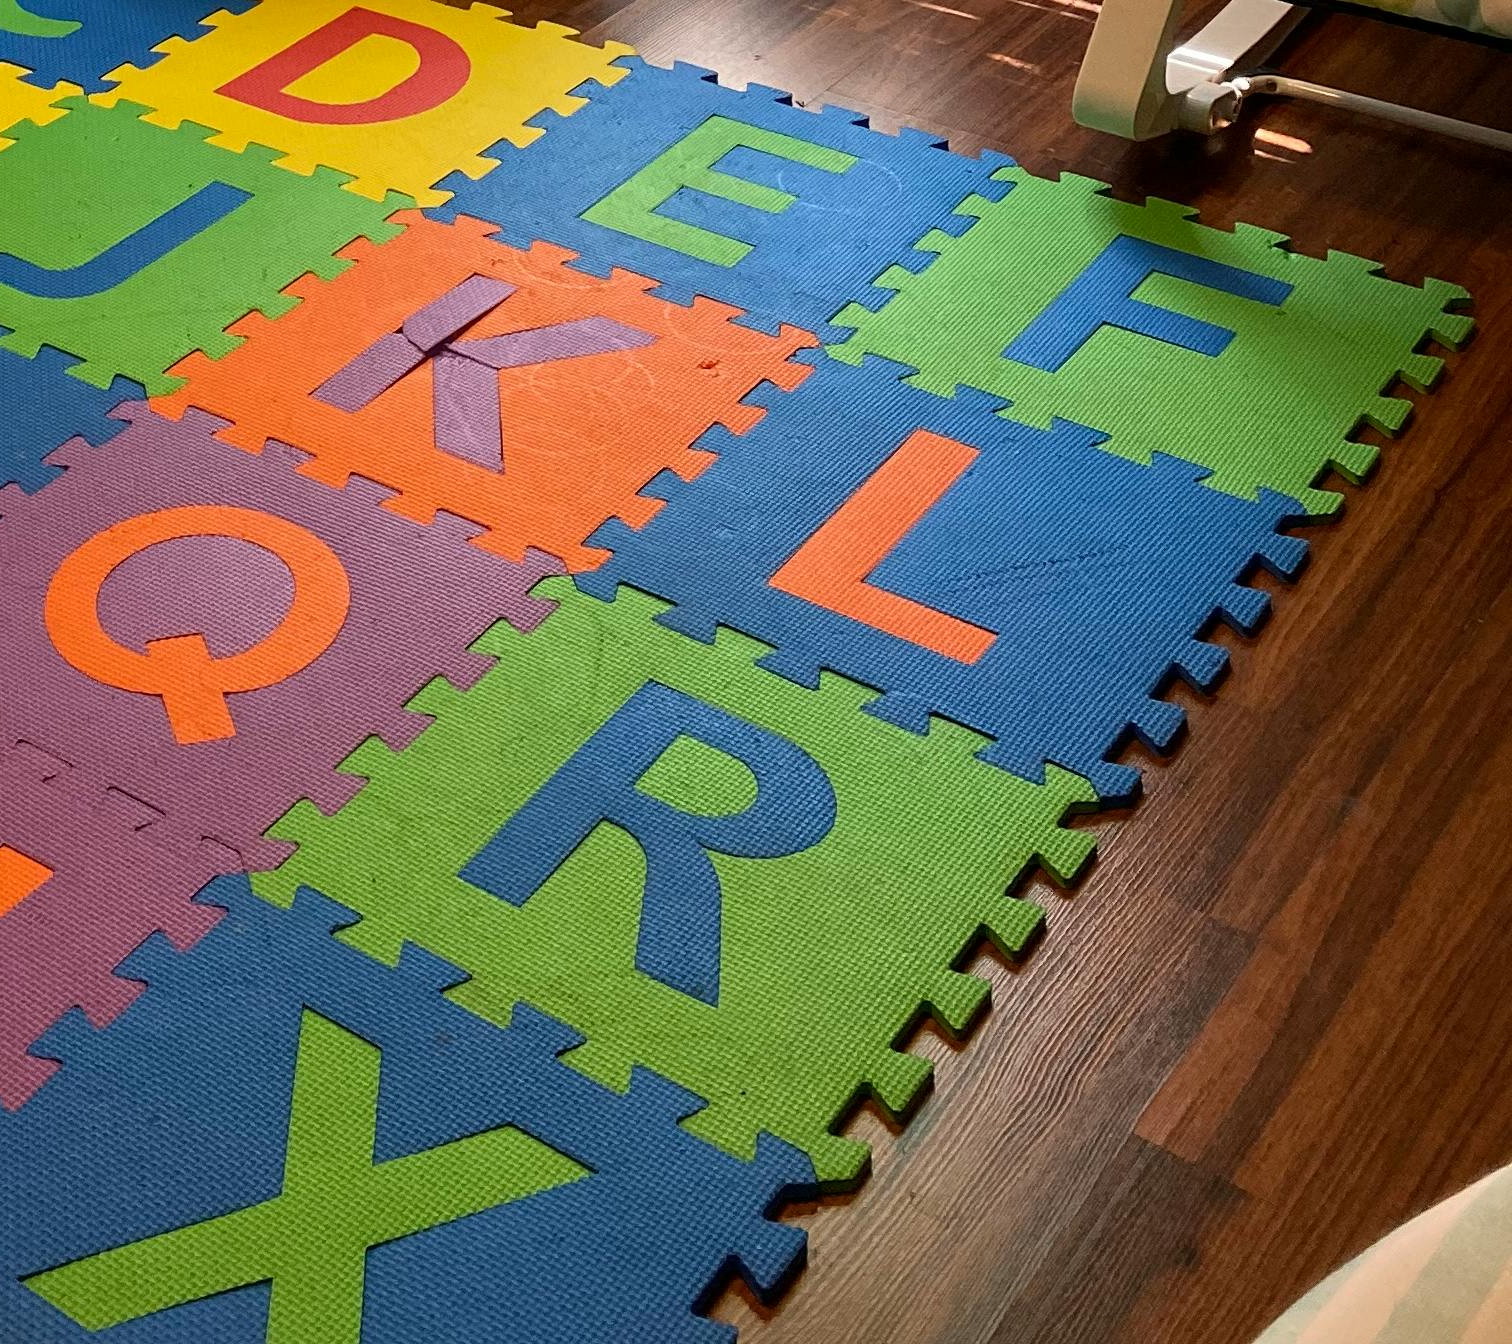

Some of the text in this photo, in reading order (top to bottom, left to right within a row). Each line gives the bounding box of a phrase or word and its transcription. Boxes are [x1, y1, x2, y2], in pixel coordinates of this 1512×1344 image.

[215, 7, 473, 127] D
[578, 113, 859, 267] E
[1000, 233, 1292, 374] F
[310, 272, 658, 472] K
[769, 430, 998, 665] L
[43, 505, 350, 745] Q
[457, 679, 838, 1007] R
[21, 1003, 596, 1344] X
